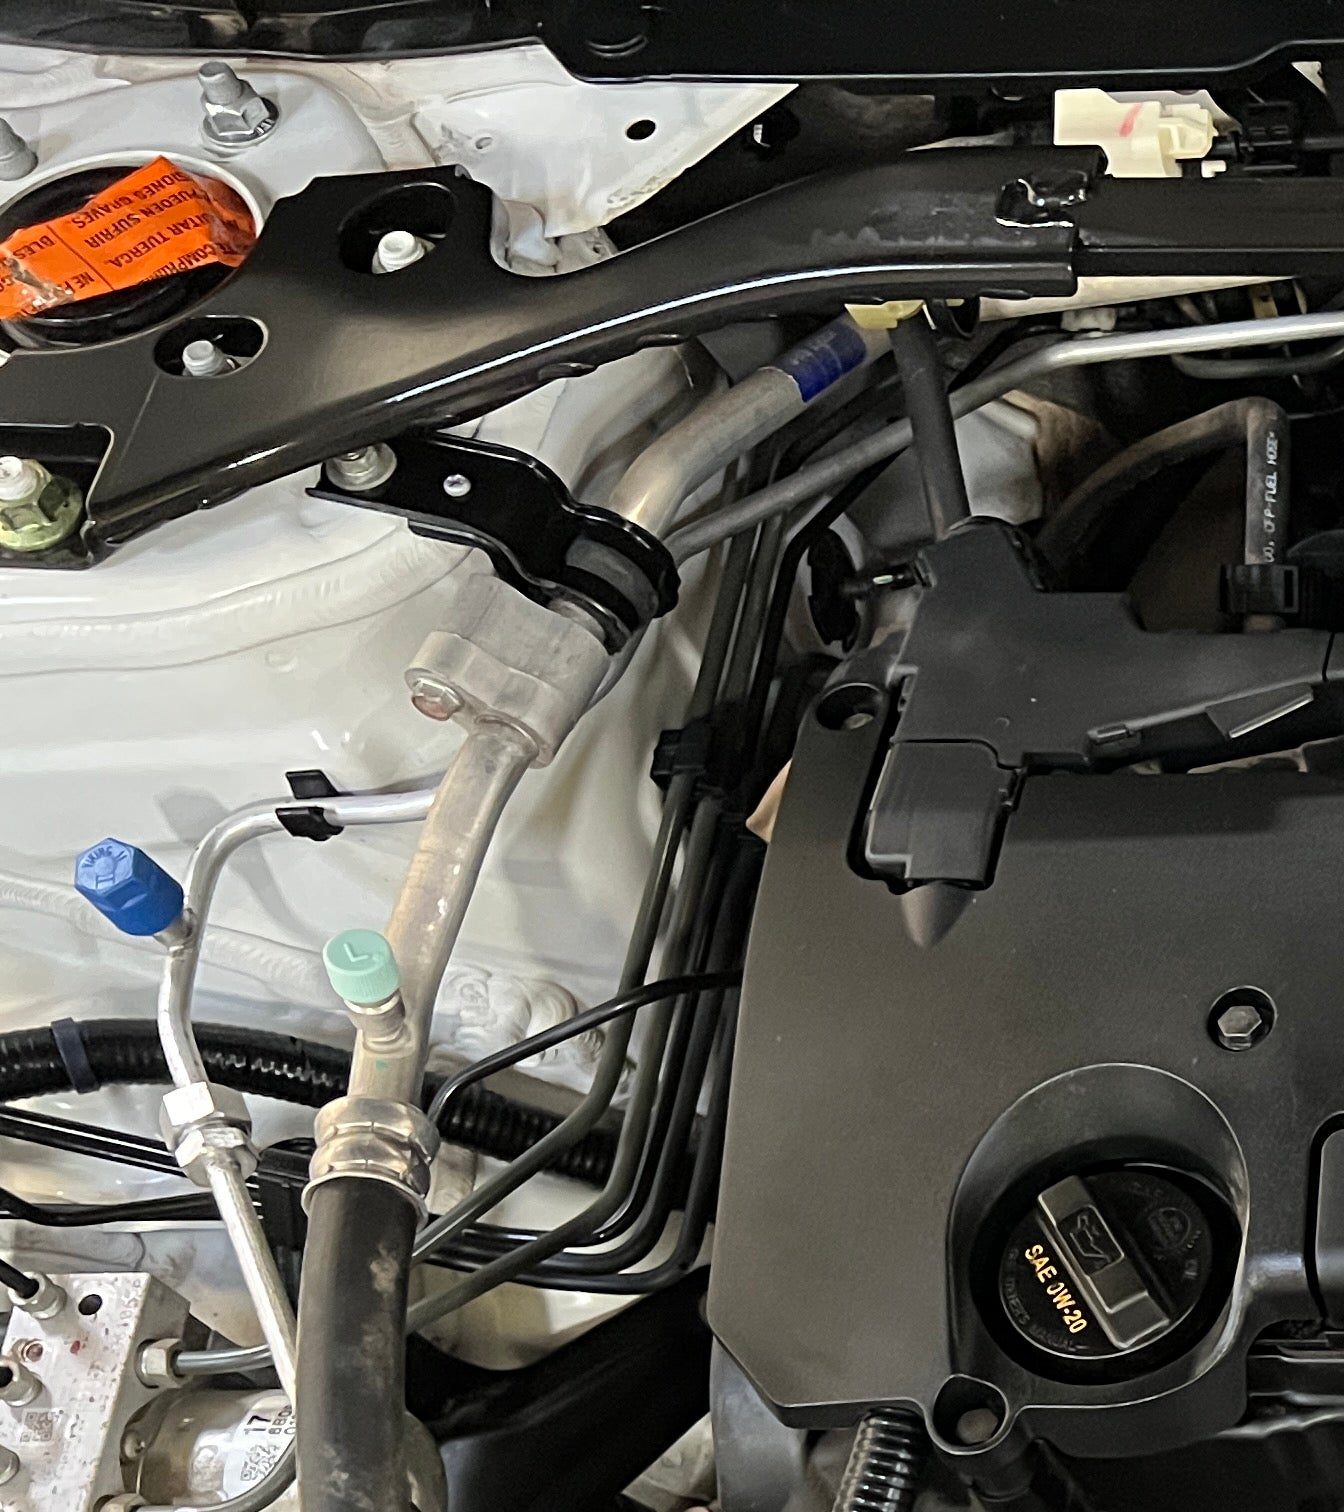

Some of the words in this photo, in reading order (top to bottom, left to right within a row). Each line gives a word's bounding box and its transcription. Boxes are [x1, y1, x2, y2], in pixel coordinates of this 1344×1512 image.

[167, 212, 210, 236] UITAR
[1025, 1244, 1058, 1284] SAE
[1046, 1282, 1088, 1334] 0W-20
